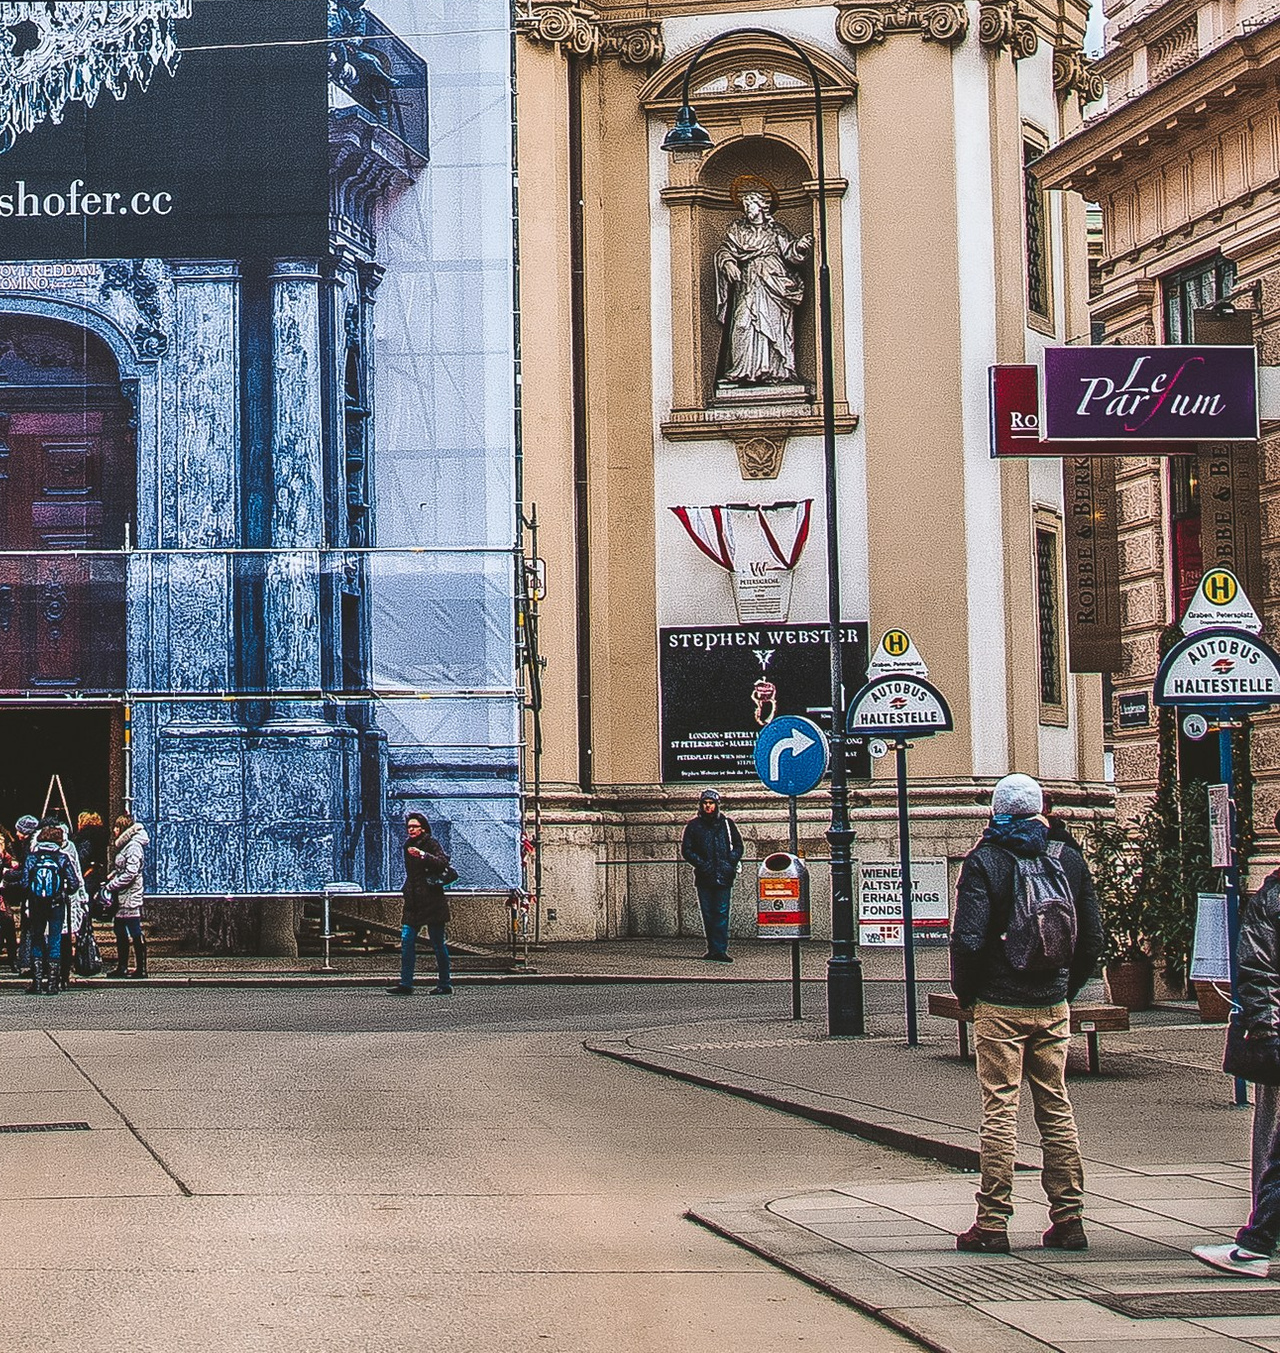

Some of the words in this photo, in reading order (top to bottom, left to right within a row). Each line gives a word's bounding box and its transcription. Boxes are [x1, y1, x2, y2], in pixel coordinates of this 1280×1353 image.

[1116, 356, 1167, 393] Le
[1076, 357, 1227, 432] Parfum
[1011, 412, 1039, 428] RO
[1073, 457, 1091, 518] BERK
[1076, 524, 1092, 540] &
[1214, 512, 1233, 570] OBBE
[1076, 547, 1096, 625] ROBBE
[1216, 611, 1253, 619] Petersplatz
[669, 631, 760, 650] STEPHEN
[767, 629, 859, 644] WEBSTER
[1187, 640, 1261, 666] AUTOBUS
[870, 682, 928, 703] AUTOBUS
[1173, 678, 1274, 694] HALTESTELLE
[860, 711, 938, 725] HALTESTELLE
[729, 739, 756, 747] MARBE
[861, 880, 920, 891] ALTSTAT
[862, 893, 940, 903] ERHALUNGS
[862, 906, 903, 915] FONDS
